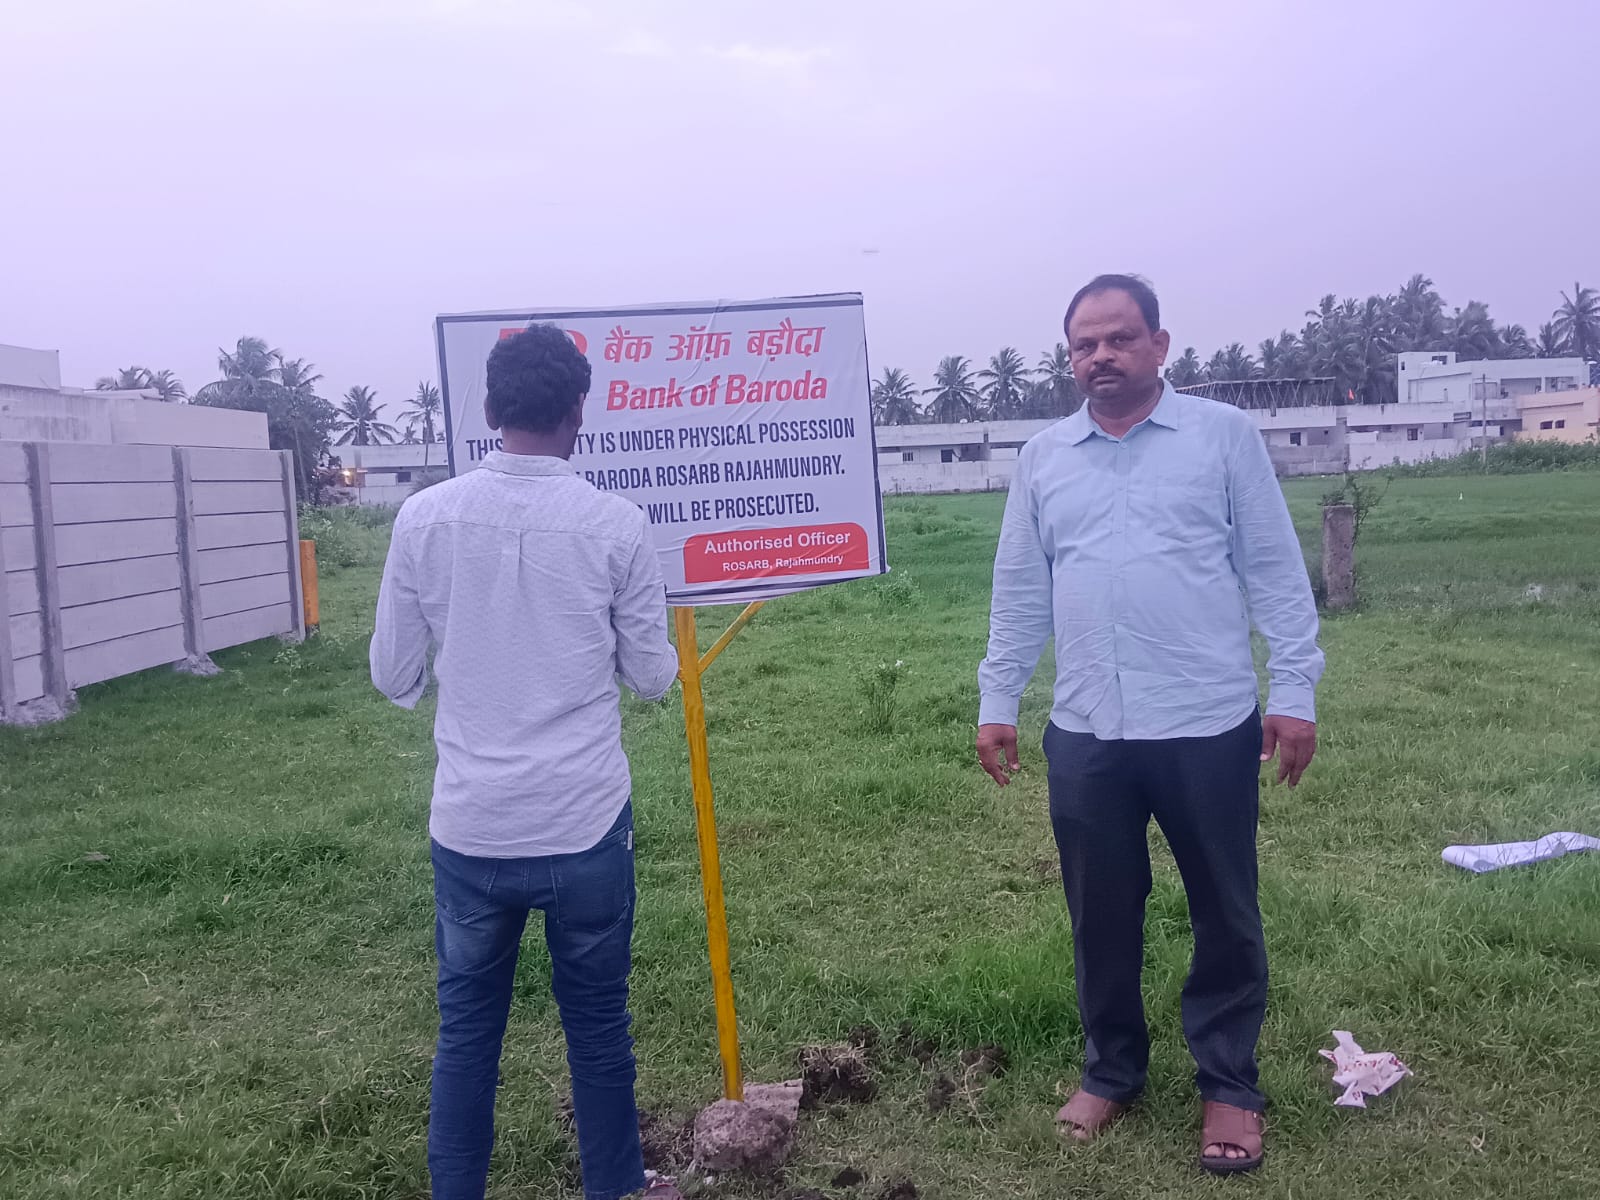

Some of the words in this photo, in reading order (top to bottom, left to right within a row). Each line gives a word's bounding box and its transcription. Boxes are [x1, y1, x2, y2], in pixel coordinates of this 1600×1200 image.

[604, 325, 654, 363] बैंक
[606, 377, 685, 411] Bank
[690, 374, 721, 407] of
[725, 370, 828, 405] Baroda
[600, 431, 616, 453] IS
[620, 428, 675, 452] UNDER
[679, 423, 756, 449] PHYSICAL
[759, 417, 855, 444] POSSESSION
[585, 467, 653, 491] BARODA
[656, 462, 720, 488] ROSARB
[724, 454, 846, 483] RAJAHMUNDRY.
[648, 501, 688, 525] WILL
[691, 499, 712, 522] BE
[714, 492, 820, 520] PROSECUTED.
[704, 534, 793, 555] Authorised
[797, 531, 851, 547] Officer
[722, 559, 773, 573] ROSARB,
[775, 554, 844, 569] Rajahmundry
